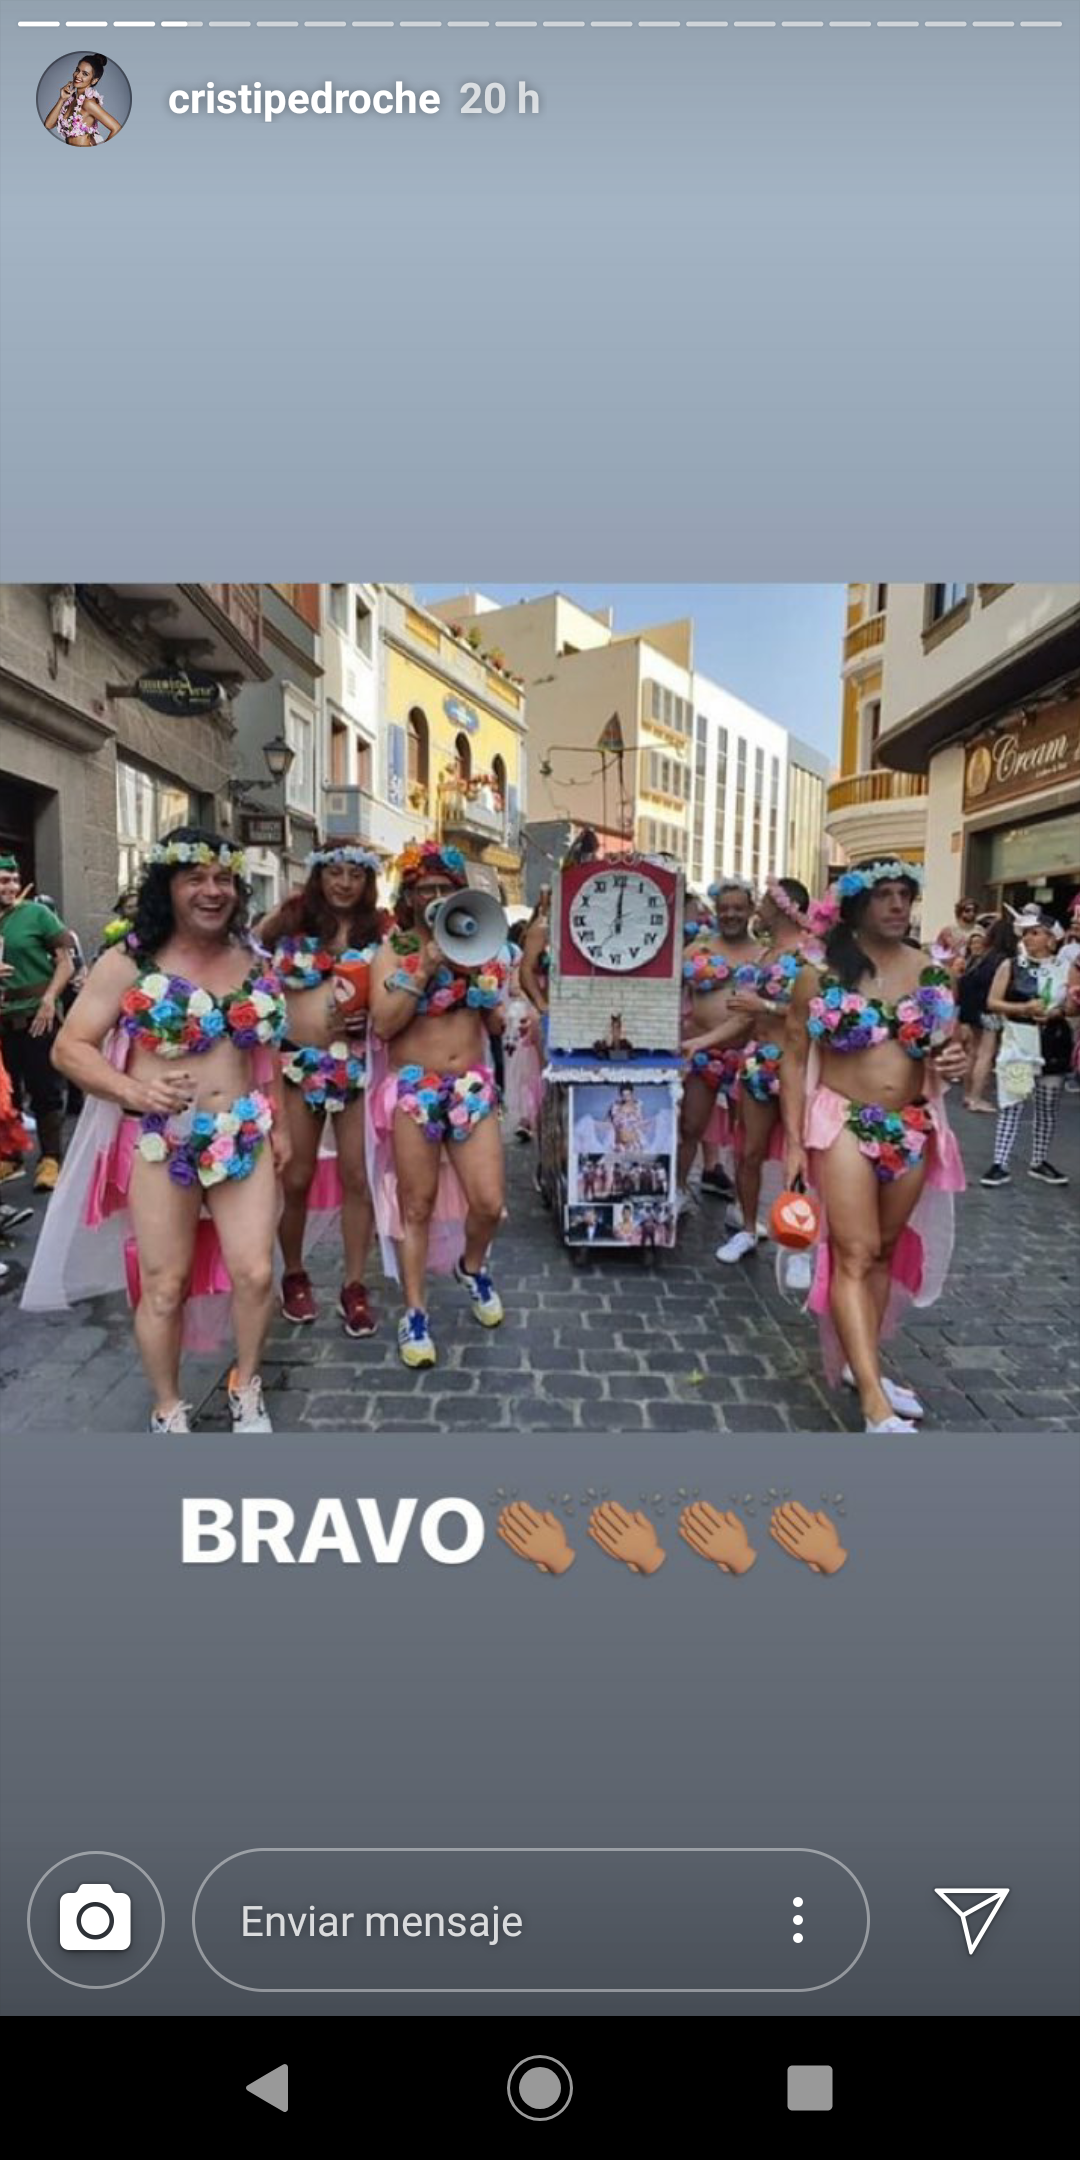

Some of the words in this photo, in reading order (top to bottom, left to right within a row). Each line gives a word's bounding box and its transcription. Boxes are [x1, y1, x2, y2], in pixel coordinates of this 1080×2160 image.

[993, 733, 1067, 782] Cream
[594, 881, 606, 893] XI
[581, 895, 590, 907] X
[644, 933, 657, 945] IV
[629, 947, 640, 958] V
[610, 954, 621, 965] VI
